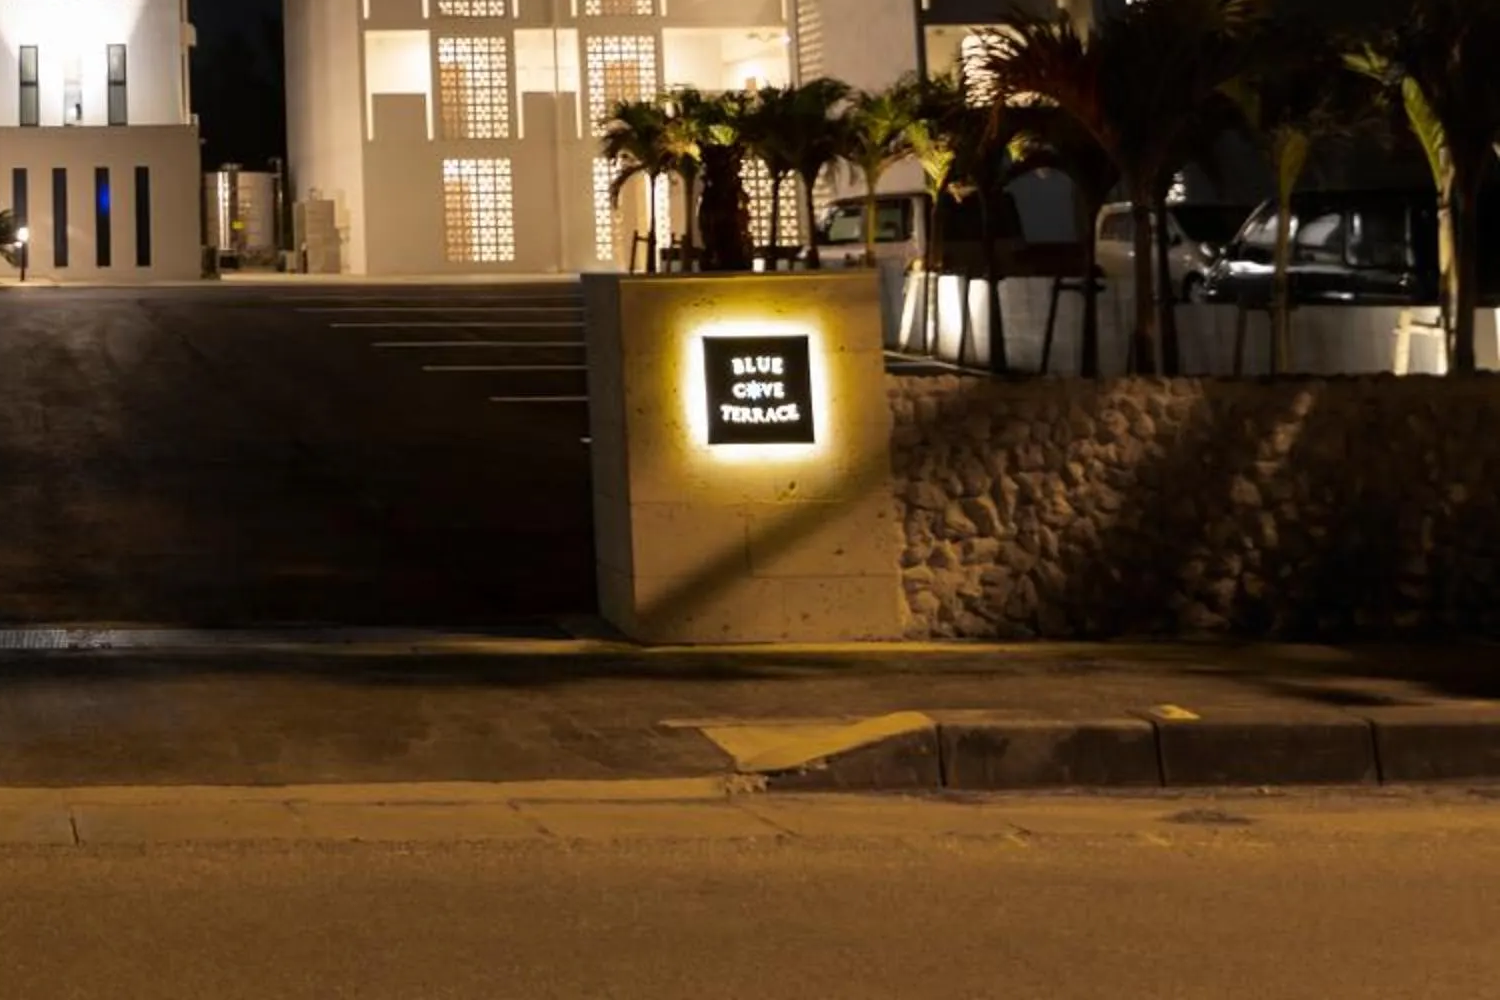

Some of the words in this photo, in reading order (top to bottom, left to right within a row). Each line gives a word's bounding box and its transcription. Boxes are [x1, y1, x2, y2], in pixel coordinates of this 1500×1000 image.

[731, 355, 784, 376] BLUE
[732, 379, 785, 401] CVE
[720, 403, 801, 424] TERRACE
